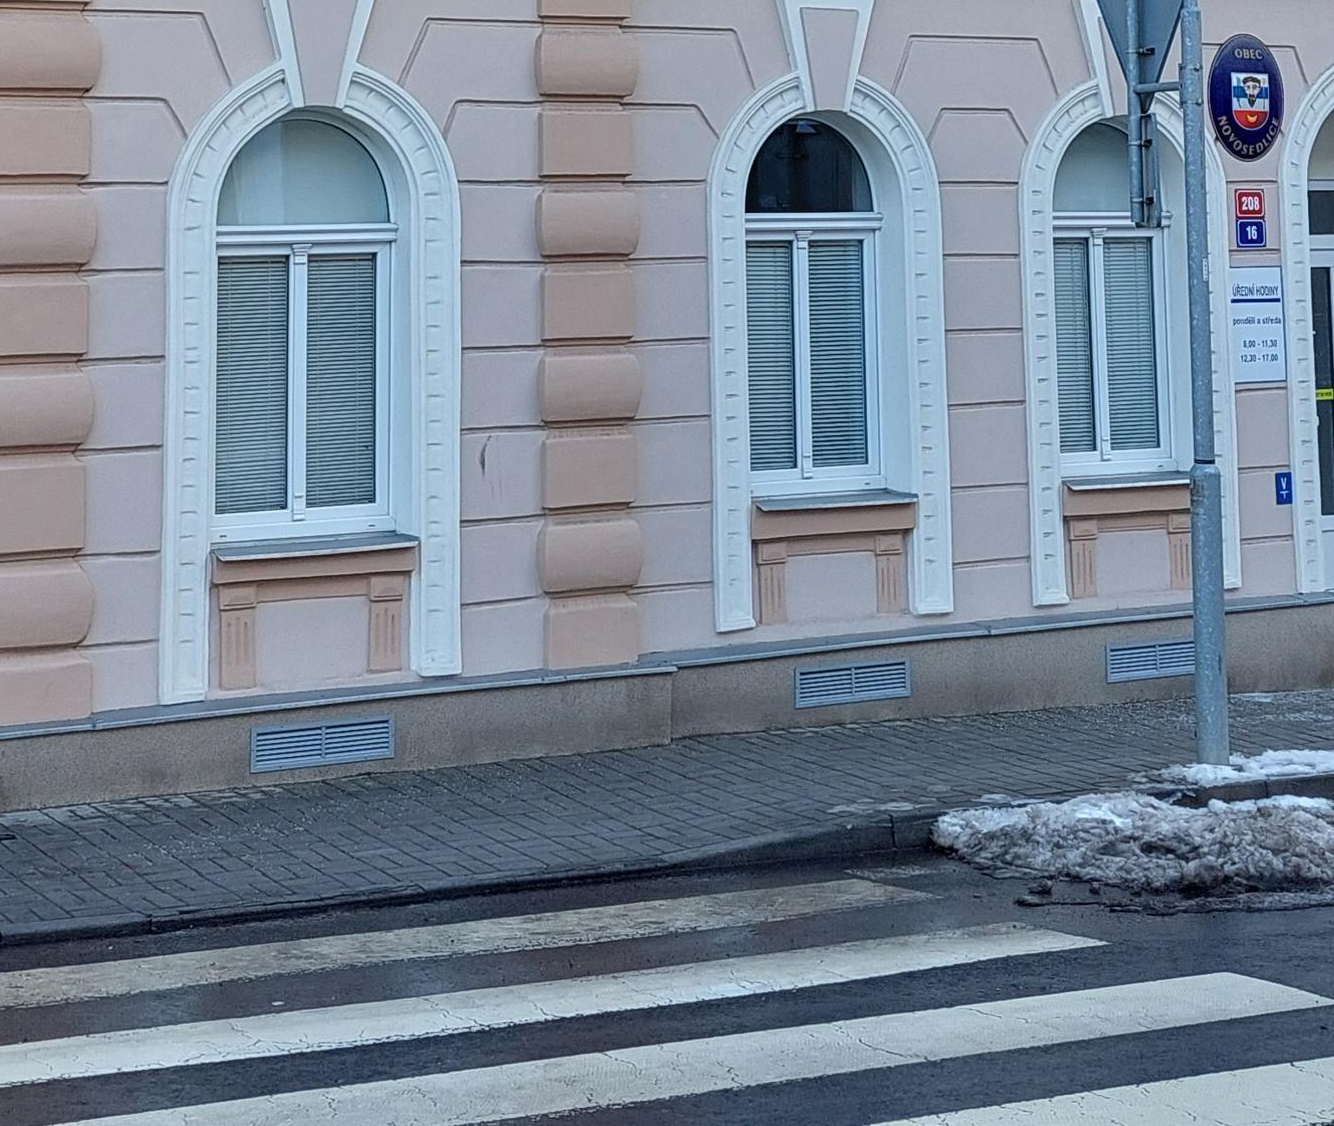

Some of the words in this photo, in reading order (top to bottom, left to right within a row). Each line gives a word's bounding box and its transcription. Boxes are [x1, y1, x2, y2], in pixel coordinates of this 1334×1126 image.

[1234, 48, 1263, 59] OBEC
[1217, 115, 1280, 155] NOVOSEDLICE
[1241, 196, 1260, 211] 208
[1246, 225, 1258, 240] 16
[1232, 283, 1255, 297] ÚŘEDNÍ
